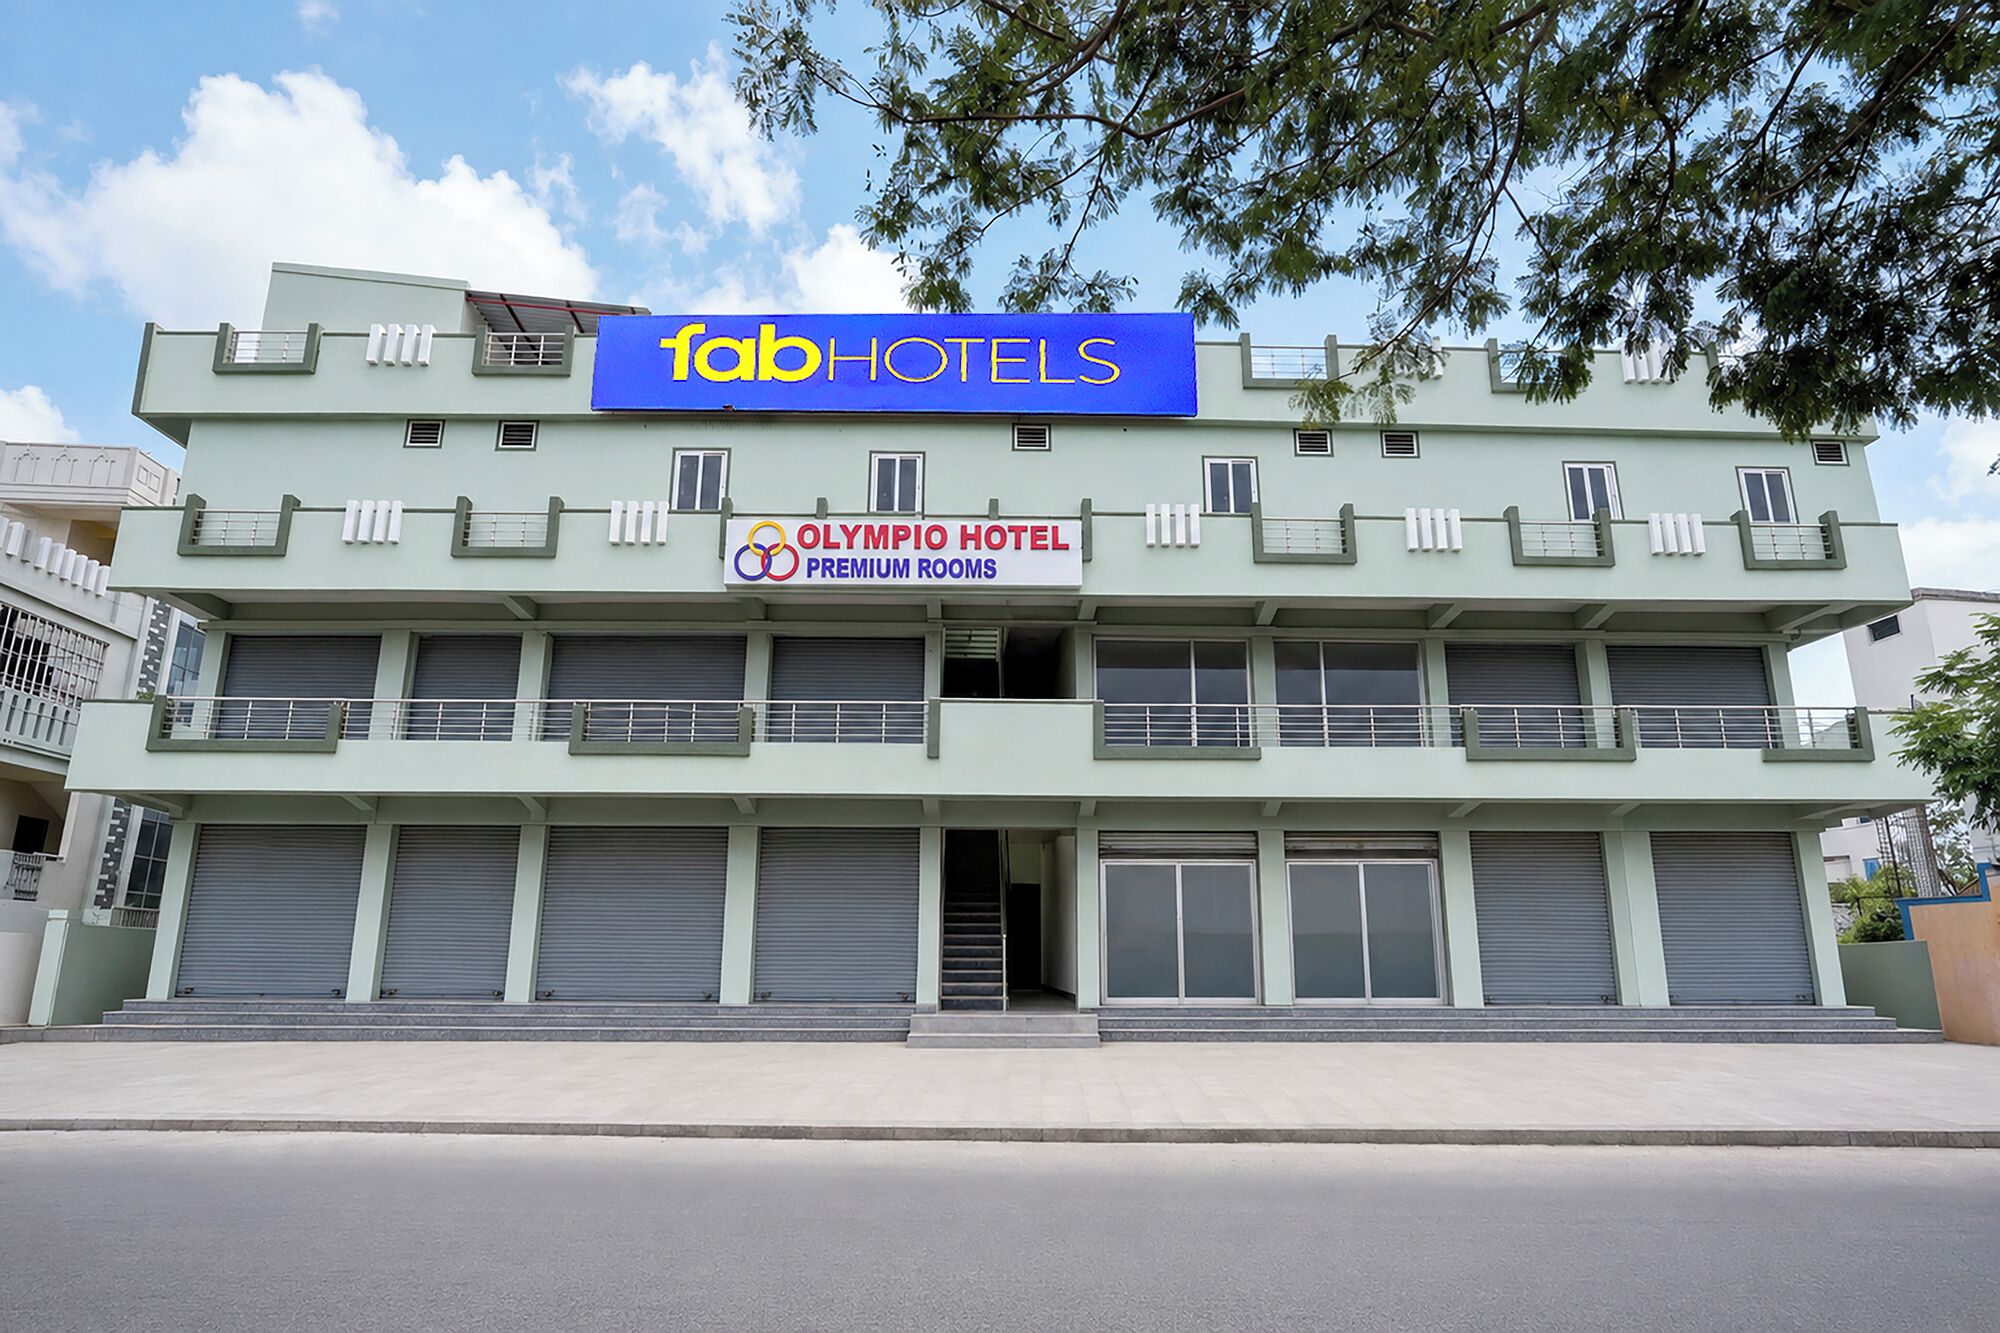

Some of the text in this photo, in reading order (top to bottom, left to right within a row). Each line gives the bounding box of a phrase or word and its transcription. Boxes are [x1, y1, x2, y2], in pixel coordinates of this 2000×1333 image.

[797, 524, 1070, 551] OLYMPIO HOTEL
[806, 557, 998, 579] PREMIUM ROOMS
